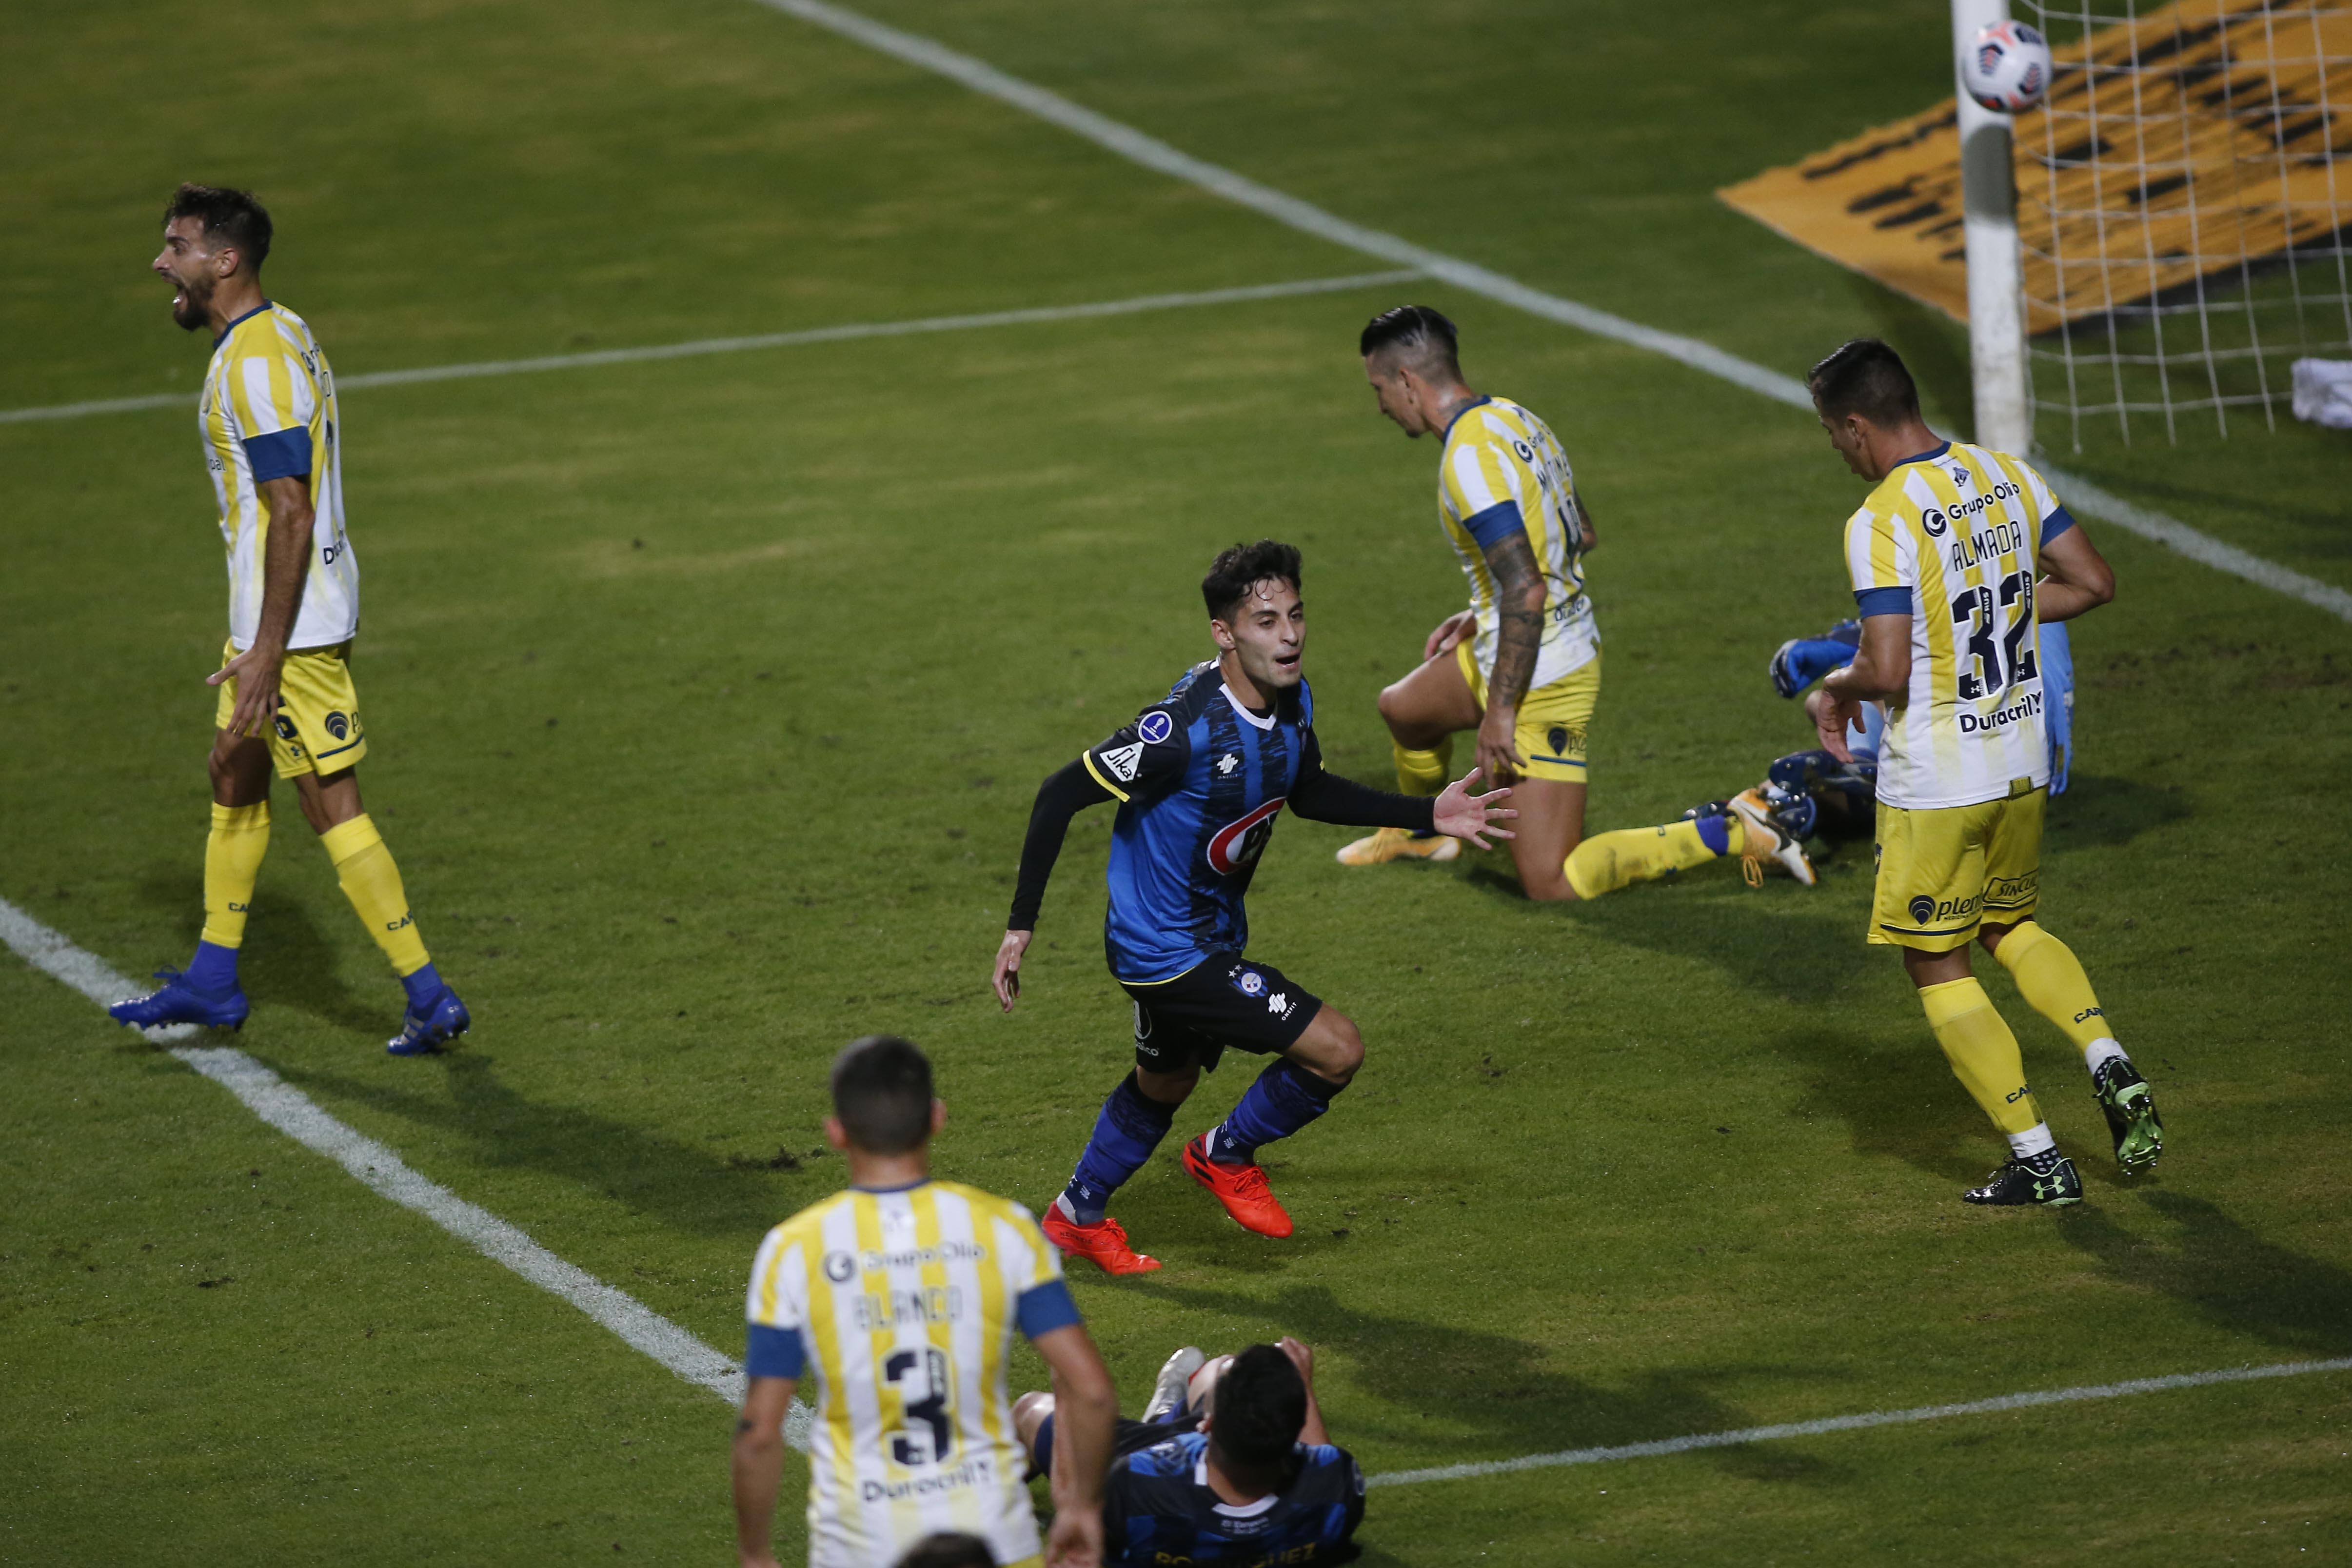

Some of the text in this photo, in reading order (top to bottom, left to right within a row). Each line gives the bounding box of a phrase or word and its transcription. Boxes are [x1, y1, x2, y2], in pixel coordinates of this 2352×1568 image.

[1949, 481, 2020, 519] Grupo Olio
[1952, 520, 2022, 572] ALMADA
[1952, 570, 2038, 700] 32
[1107, 747, 1136, 779] Sika
[861, 1246, 939, 1270] Grupo
[852, 1284, 963, 1331] BLANCO
[885, 1347, 951, 1466] 3
